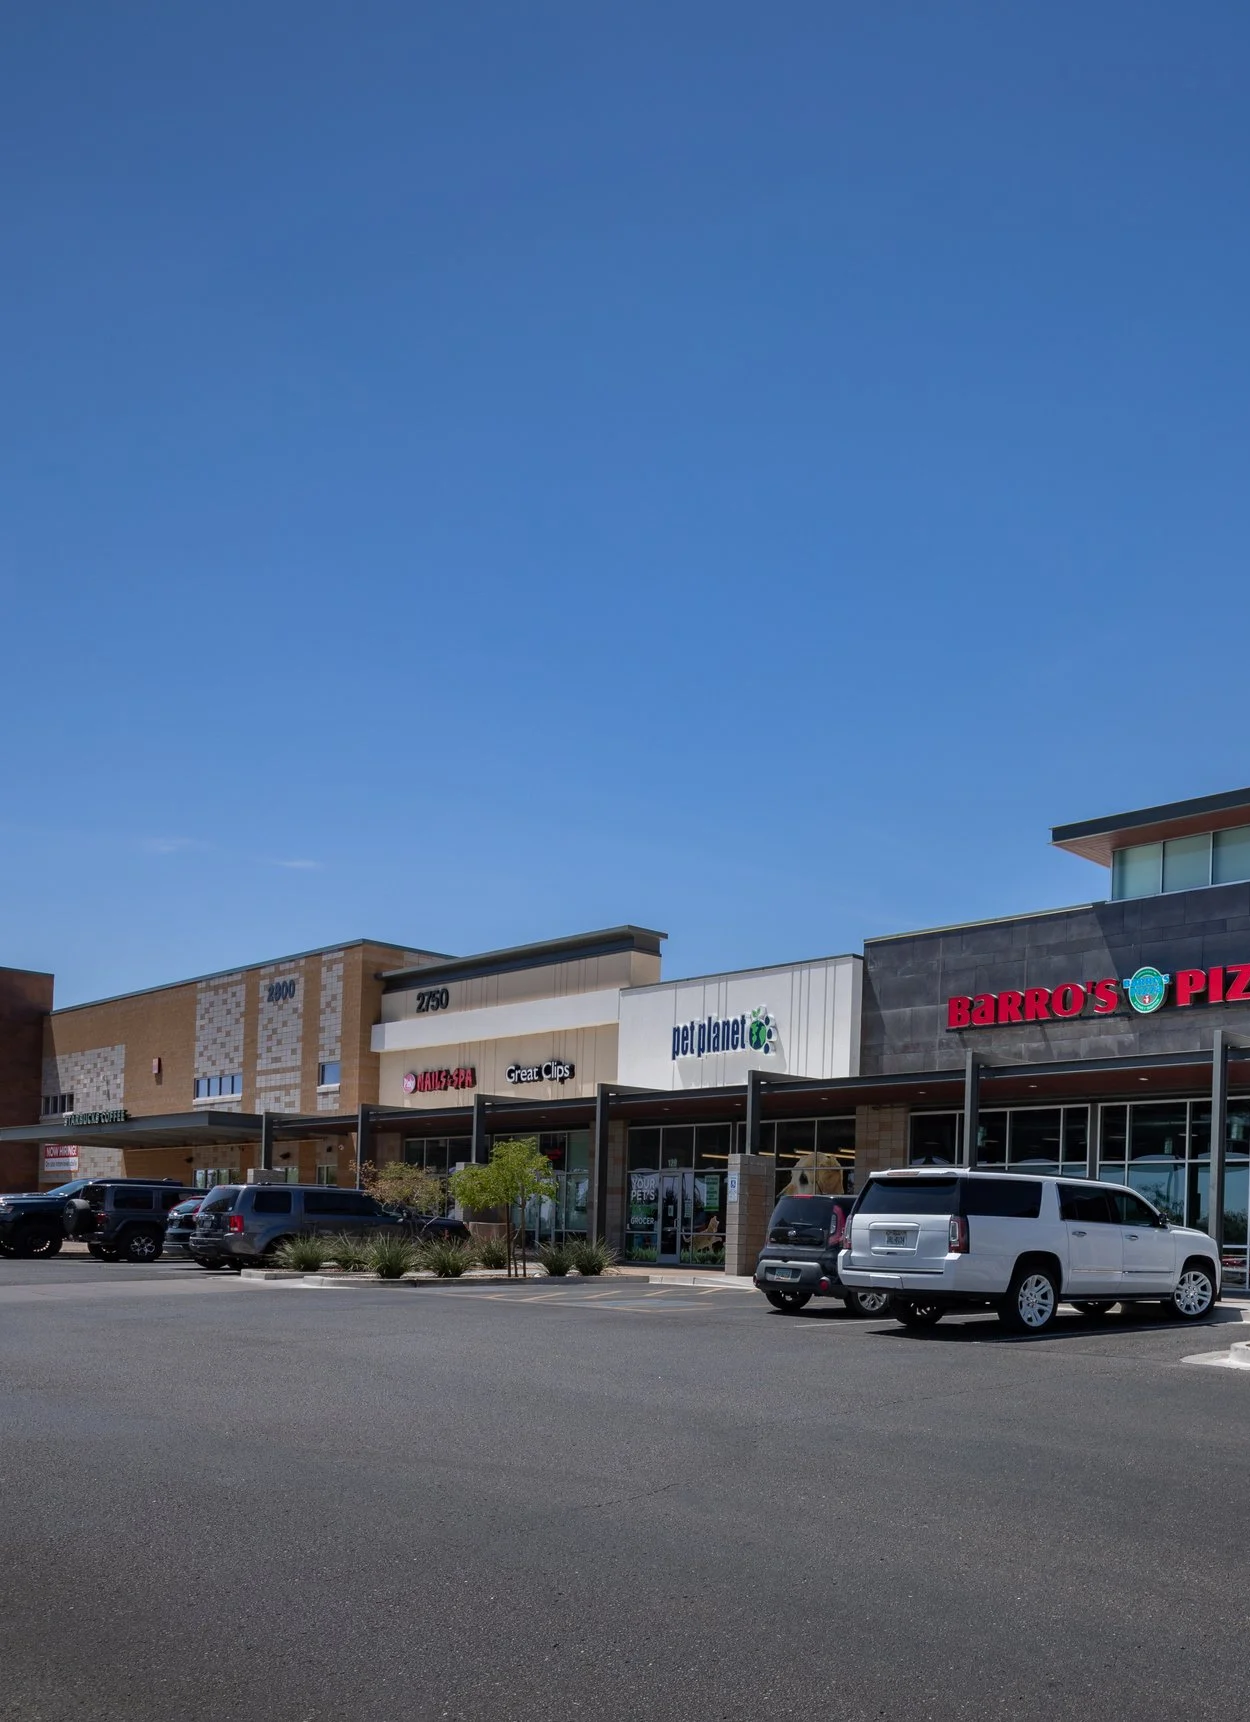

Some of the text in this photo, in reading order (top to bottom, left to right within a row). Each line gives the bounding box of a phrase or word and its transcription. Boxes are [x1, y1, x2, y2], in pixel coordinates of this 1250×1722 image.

[267, 980, 296, 1002] 2800
[416, 988, 450, 1013] 2750
[671, 1014, 746, 1060] pet planet
[416, 1070, 447, 1092] NAILS
[453, 1067, 474, 1088] SPA
[505, 1061, 571, 1083] Great Clips
[63, 1109, 126, 1127] STARBUCKS COFFEE
[46, 1146, 59, 1157] NOW
[631, 1178, 656, 1190] YOUR
[631, 1189, 656, 1201] PET'S
[630, 1217, 655, 1225] GROCER
